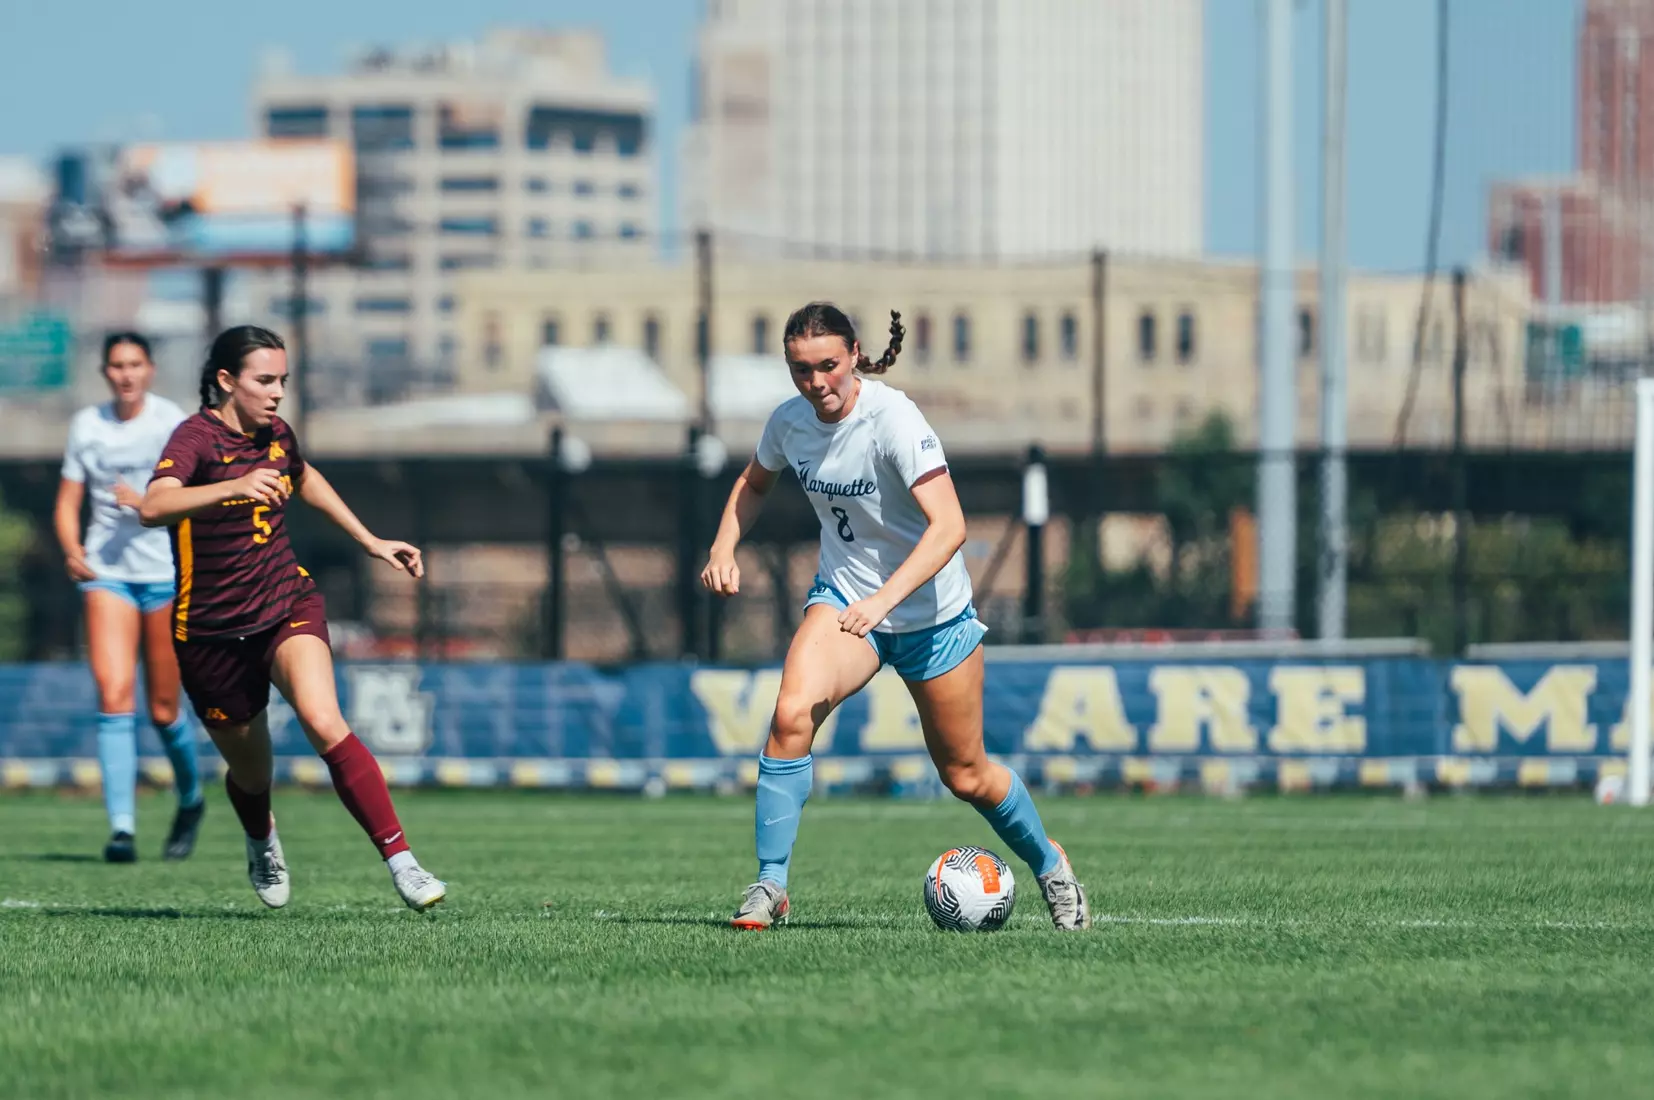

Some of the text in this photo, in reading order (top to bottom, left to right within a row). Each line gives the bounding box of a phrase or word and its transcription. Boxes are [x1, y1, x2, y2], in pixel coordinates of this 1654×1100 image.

[800, 466, 876, 501] Marquette
[253, 505, 272, 543] 5
[831, 506, 855, 542] 8
[1023, 665, 1367, 752] ARE
